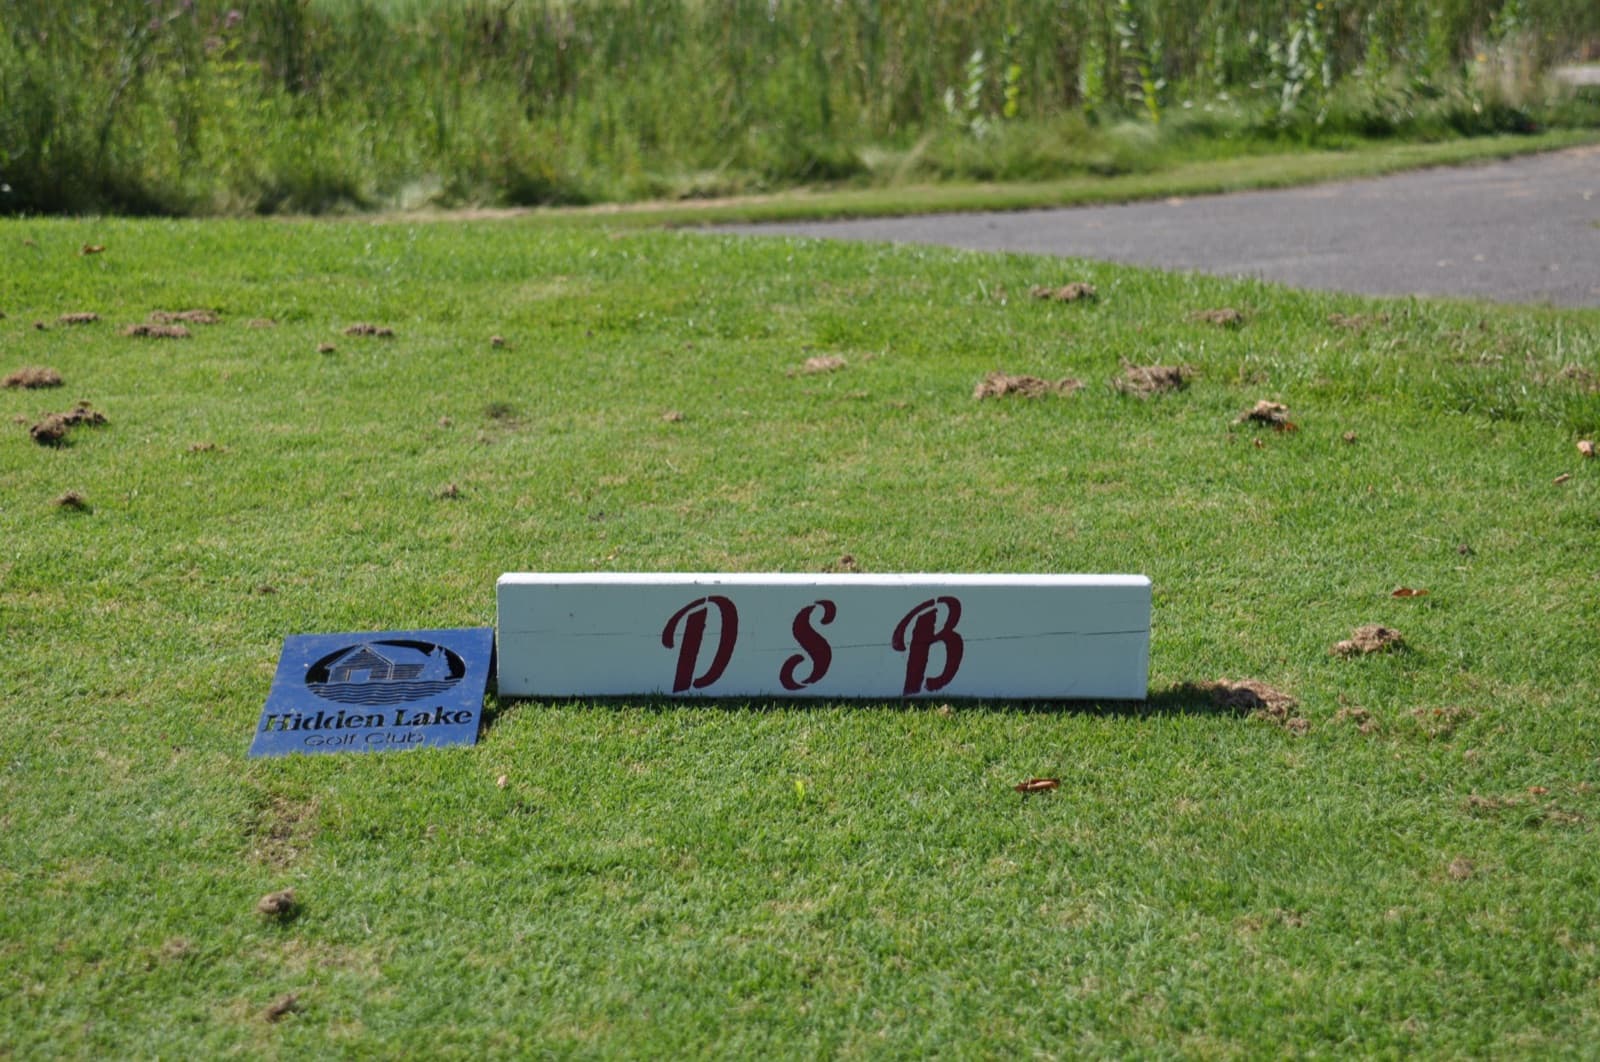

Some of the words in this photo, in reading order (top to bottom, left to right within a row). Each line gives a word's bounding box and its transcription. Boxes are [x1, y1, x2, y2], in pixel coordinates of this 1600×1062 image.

[661, 595, 739, 693] D
[779, 599, 837, 691] S
[892, 595, 964, 697] B
[262, 708, 385, 733] Hidden
[394, 706, 473, 727] Lake
[304, 732, 358, 747] Golf
[365, 731, 425, 745] Club
